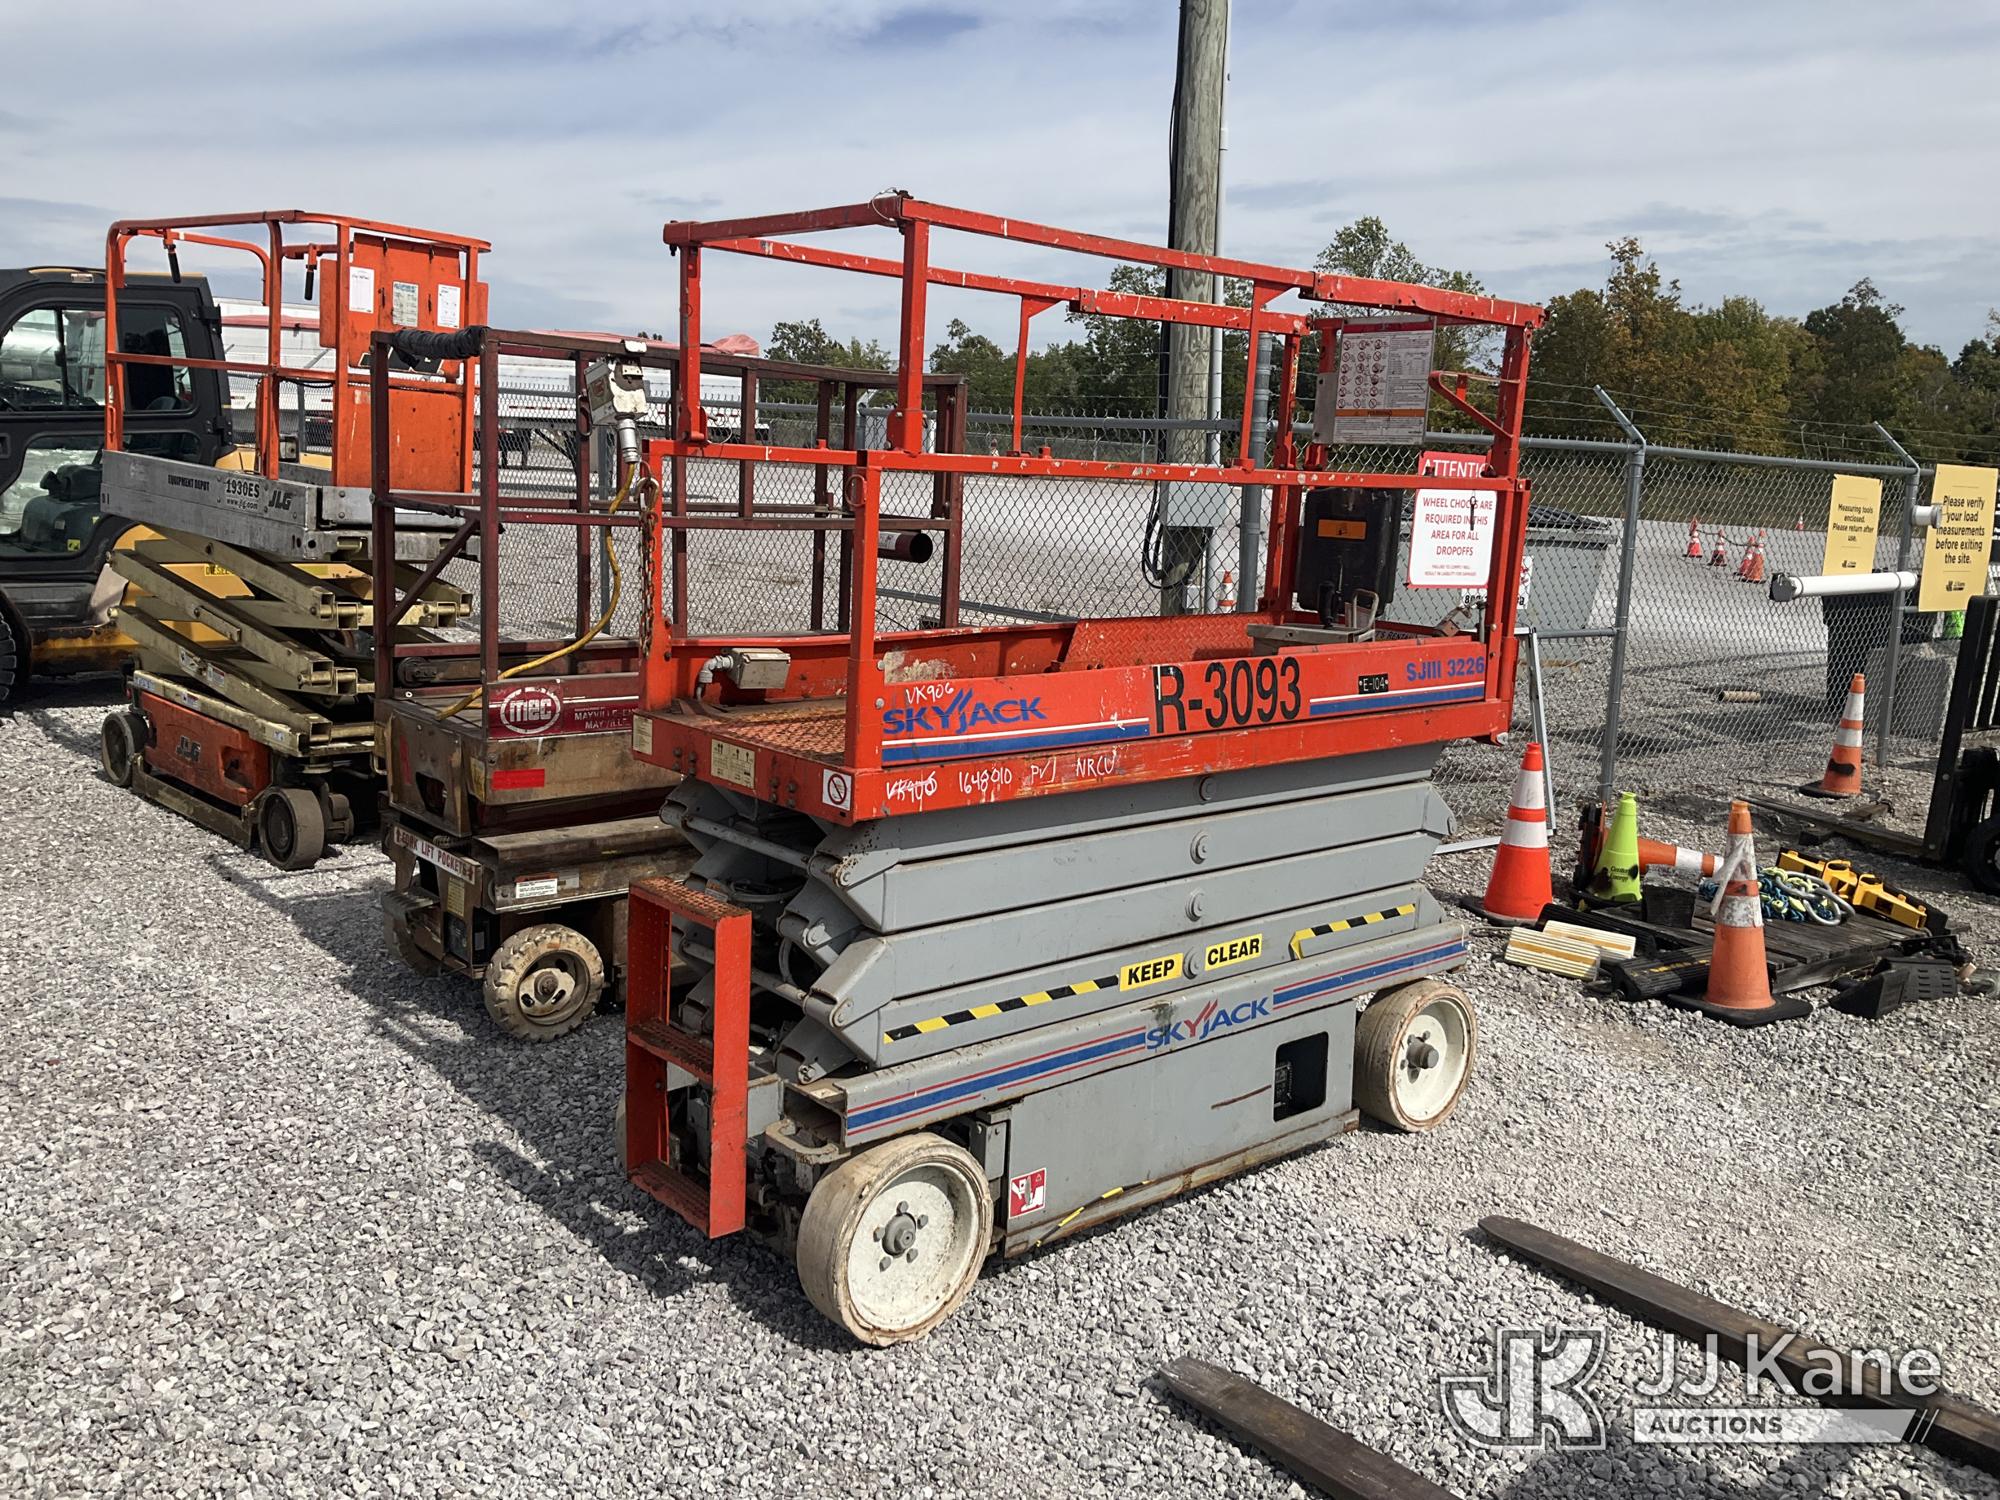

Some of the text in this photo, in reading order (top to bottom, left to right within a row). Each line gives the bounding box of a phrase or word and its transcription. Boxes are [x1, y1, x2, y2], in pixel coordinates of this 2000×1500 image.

[168, 474, 210, 491] EQUIPMENT DEPOT
[226, 479, 260, 498] 1930ES
[268, 490, 293, 510] JLG
[1423, 497, 1493, 510] WHEEL CHOCS ARE
[1943, 495, 1985, 511] Please verify
[1425, 513, 1462, 525] REQUIRED
[1463, 516, 1472, 525] IN
[1946, 510, 1979, 524] your load
[1431, 530, 1479, 541] AREA FOR ALL
[1833, 522, 1848, 531] Please
[1863, 525, 1874, 533] after
[1936, 526, 1985, 536] measurements
[1436, 546, 1474, 556] DROPOFFS
[1936, 538, 1983, 552] before exiting
[1945, 552, 1971, 564] the site.
[1406, 656, 1485, 682] SJIII 3226
[1362, 677, 1385, 692] E-104
[905, 682, 955, 704] VK906
[1153, 656, 1301, 734] R-3093
[883, 688, 1048, 735] SKYJACK
[959, 767, 1012, 794] 1648010
[421, 841, 434, 860] LIFT
[437, 850, 467, 877] POCKETS
[1127, 938, 1260, 985] KEEP CLEAR
[1145, 997, 1270, 1051] SKYJACK
